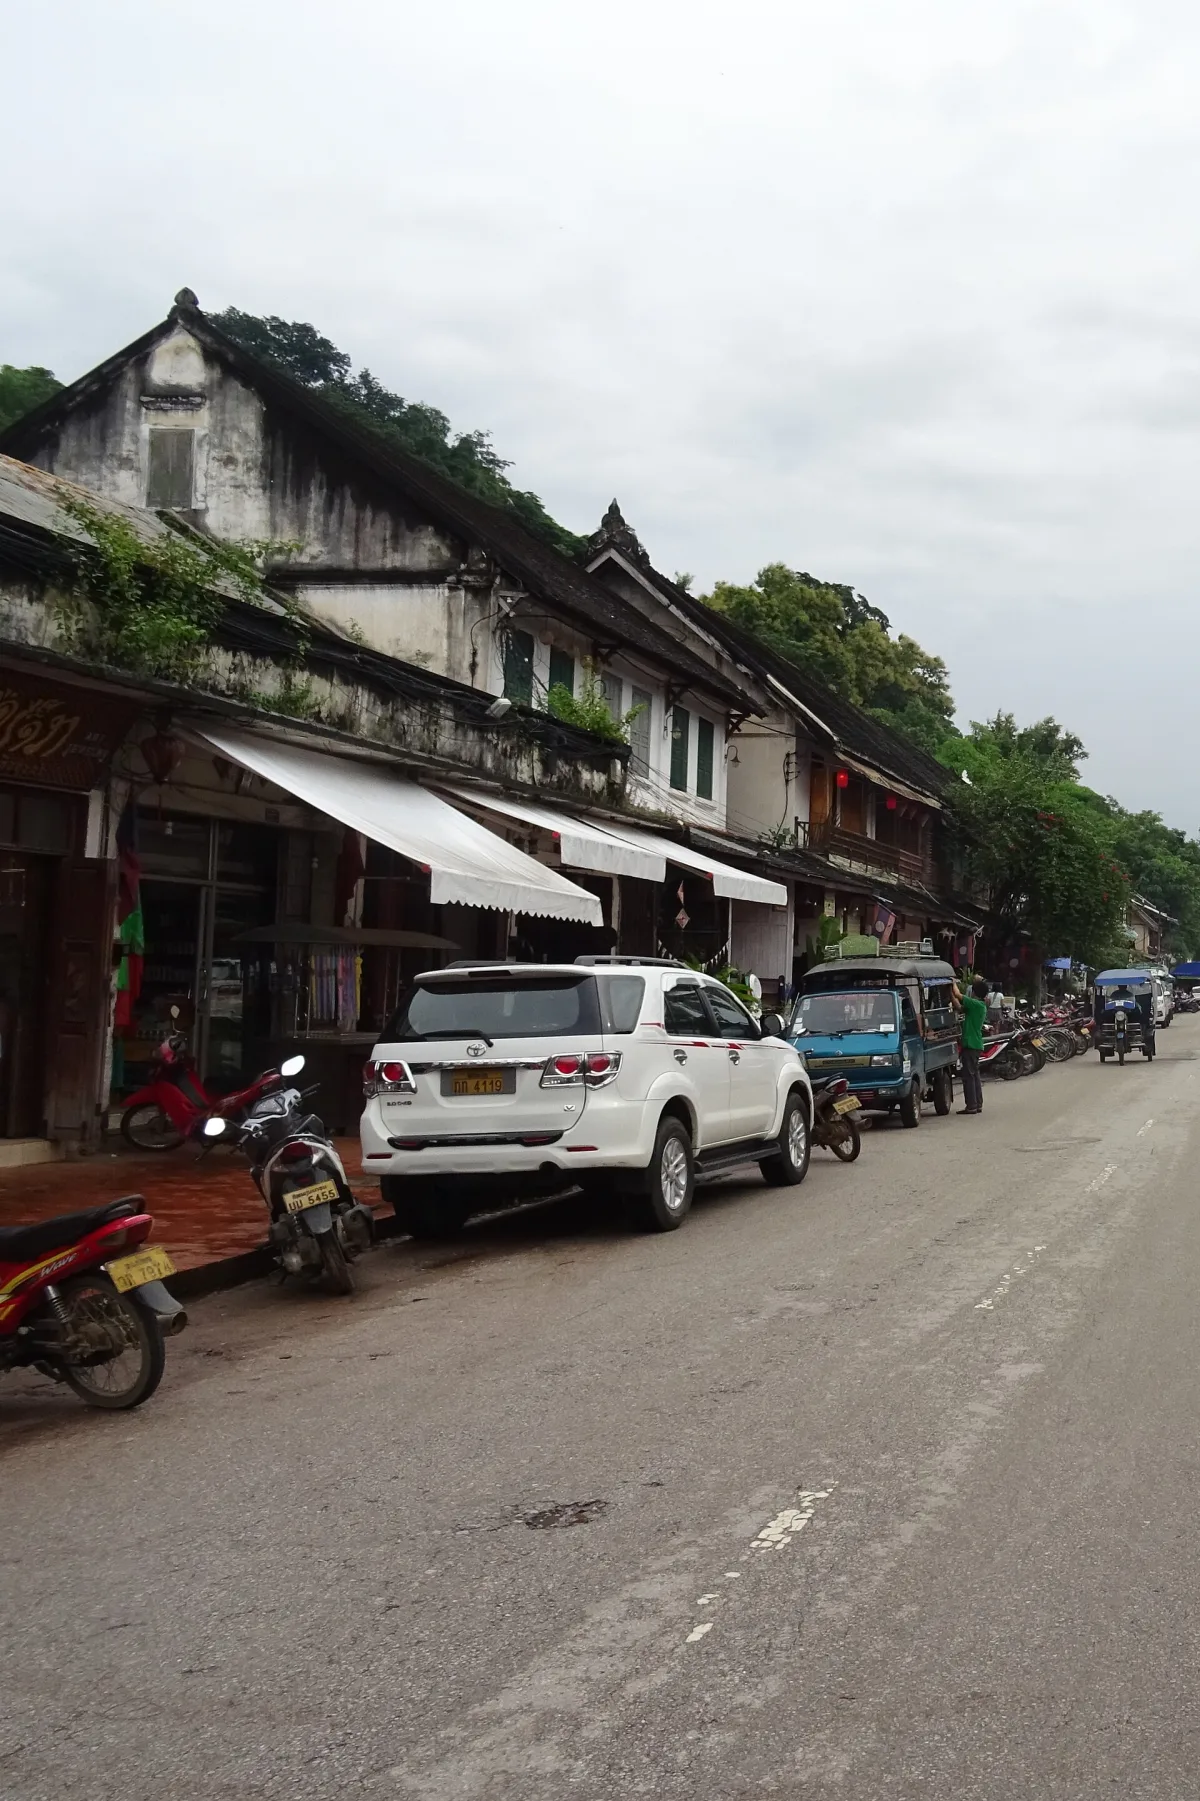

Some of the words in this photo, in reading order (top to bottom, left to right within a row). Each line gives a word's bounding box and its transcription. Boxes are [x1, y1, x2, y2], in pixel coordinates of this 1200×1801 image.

[474, 1079, 502, 1093] 4119
[308, 1189, 335, 1205] 5455
[40, 1253, 79, 1277] Wave
